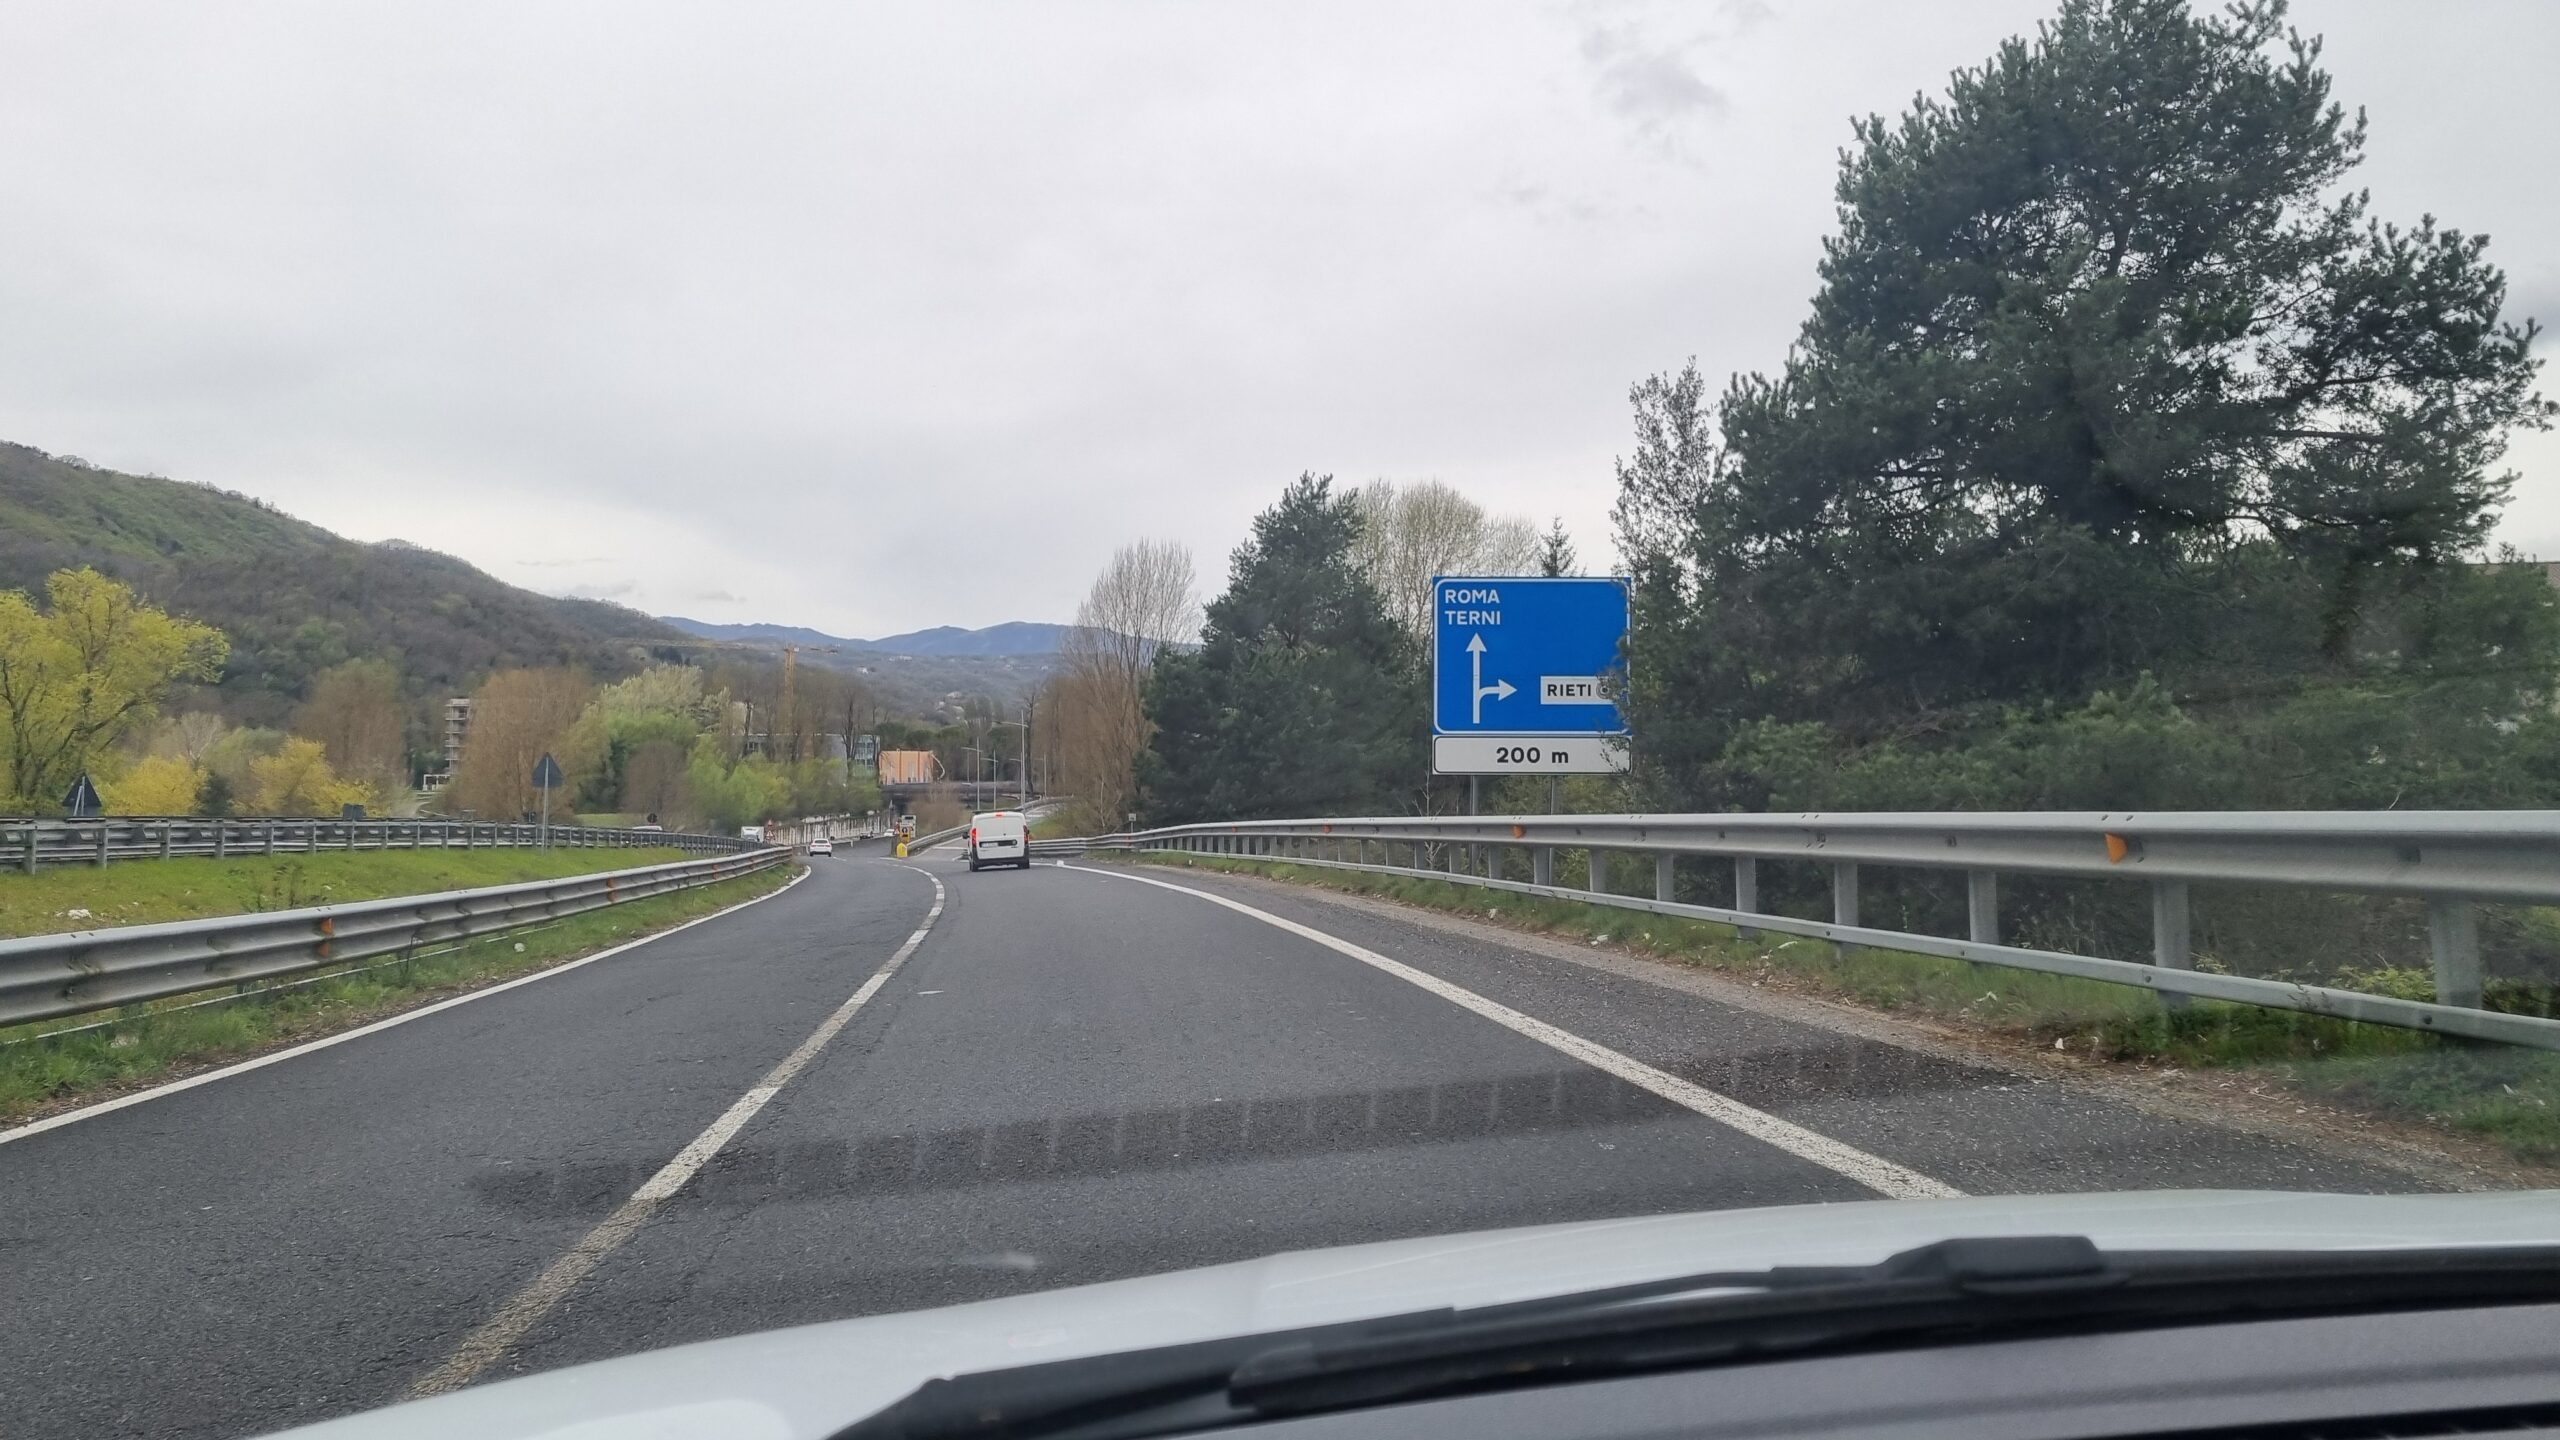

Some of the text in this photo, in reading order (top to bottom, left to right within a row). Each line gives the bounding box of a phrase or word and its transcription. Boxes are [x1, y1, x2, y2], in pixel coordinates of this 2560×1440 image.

[1445, 589, 1500, 604] ROMA
[1445, 611, 1501, 625] TERNI
[1547, 684, 1592, 697] RIETI
[1496, 747, 1569, 763] 200 m
